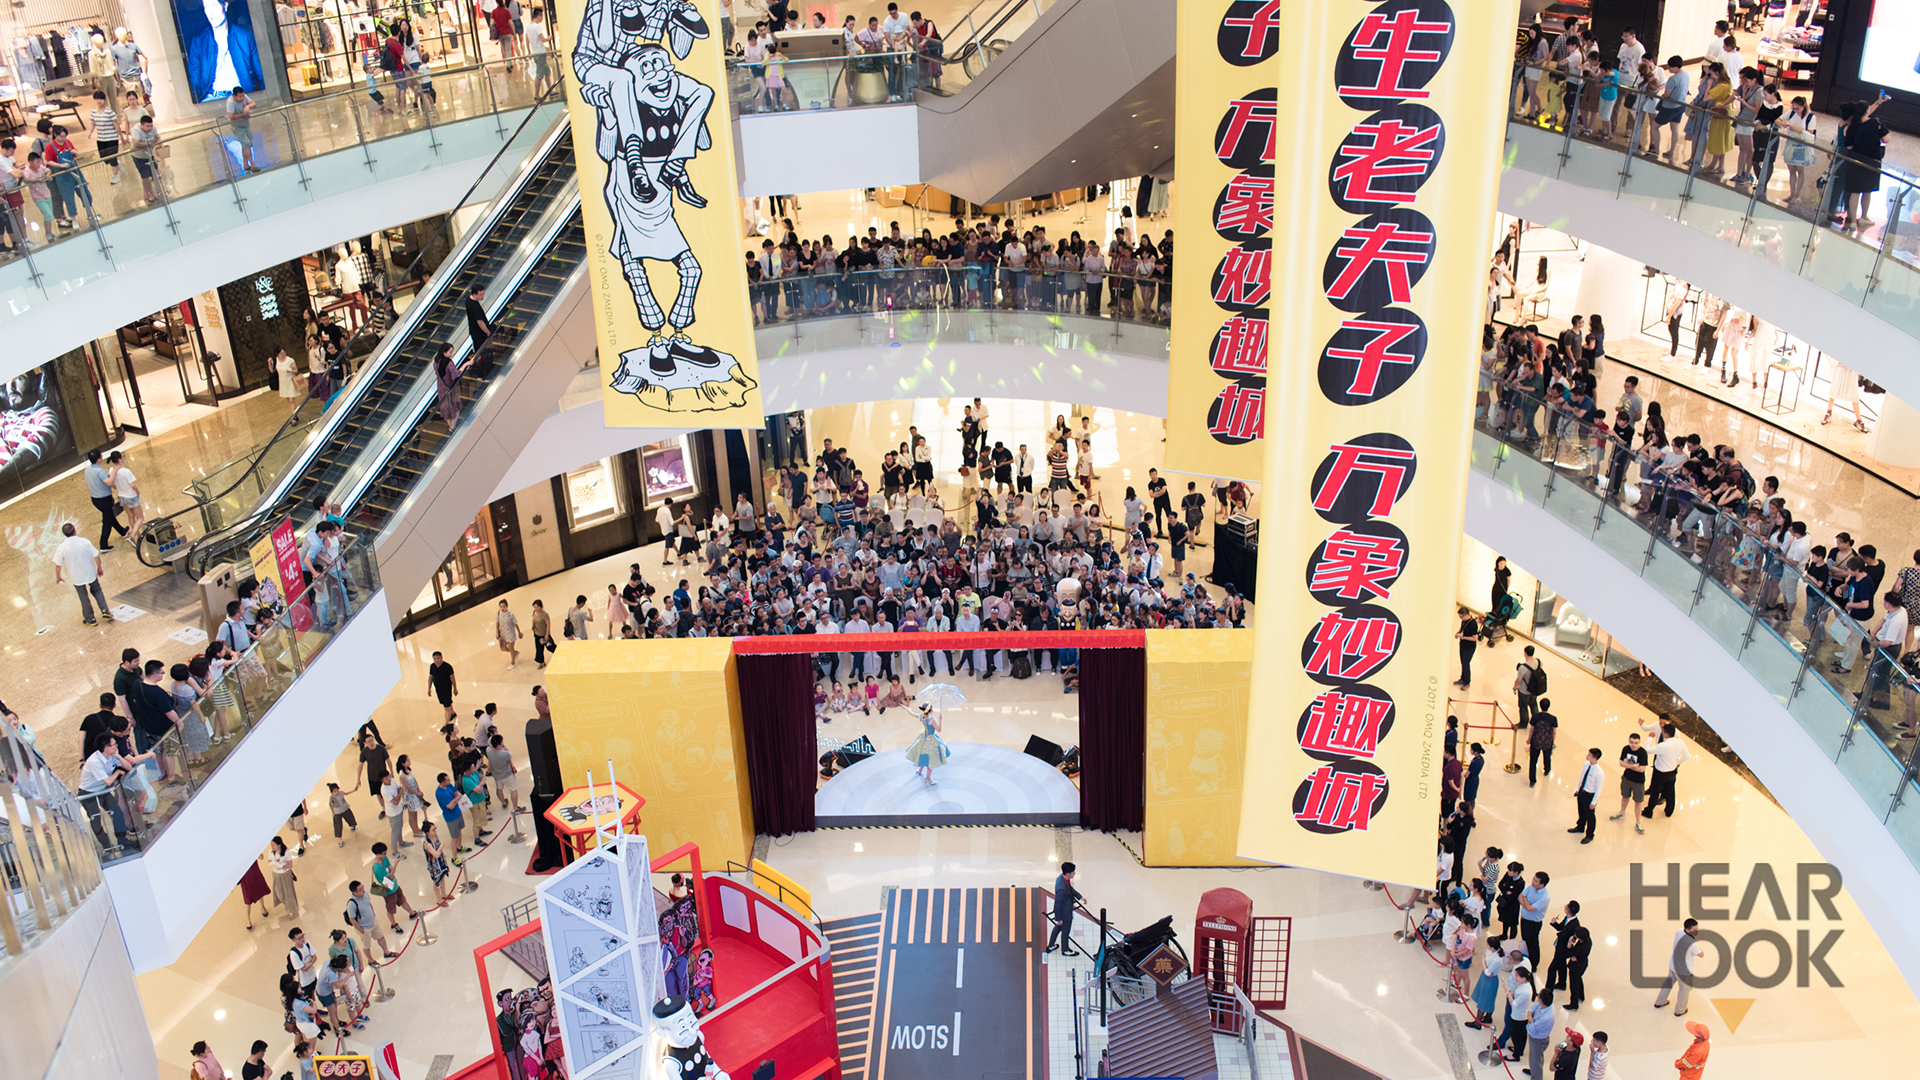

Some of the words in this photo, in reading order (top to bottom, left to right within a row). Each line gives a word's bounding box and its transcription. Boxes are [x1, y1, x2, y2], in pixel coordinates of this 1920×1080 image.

[1325, 8, 1451, 397] 生老夫子
[596, 243, 606, 264] 2017
[599, 267, 609, 290] OMQ
[603, 293, 614, 327] ZMEDIA
[607, 330, 617, 347] LTD.
[276, 529, 293, 551] SALE
[1294, 443, 1416, 832] 万象妙趣城
[1427, 686, 1437, 710] 2017
[1423, 713, 1434, 739] OMQ
[1420, 740, 1432, 778] ZMEDIA
[1418, 782, 1428, 800] LTD.
[891, 1024, 949, 1050] SLOW
[321, 1062, 363, 1076] 老夫子
